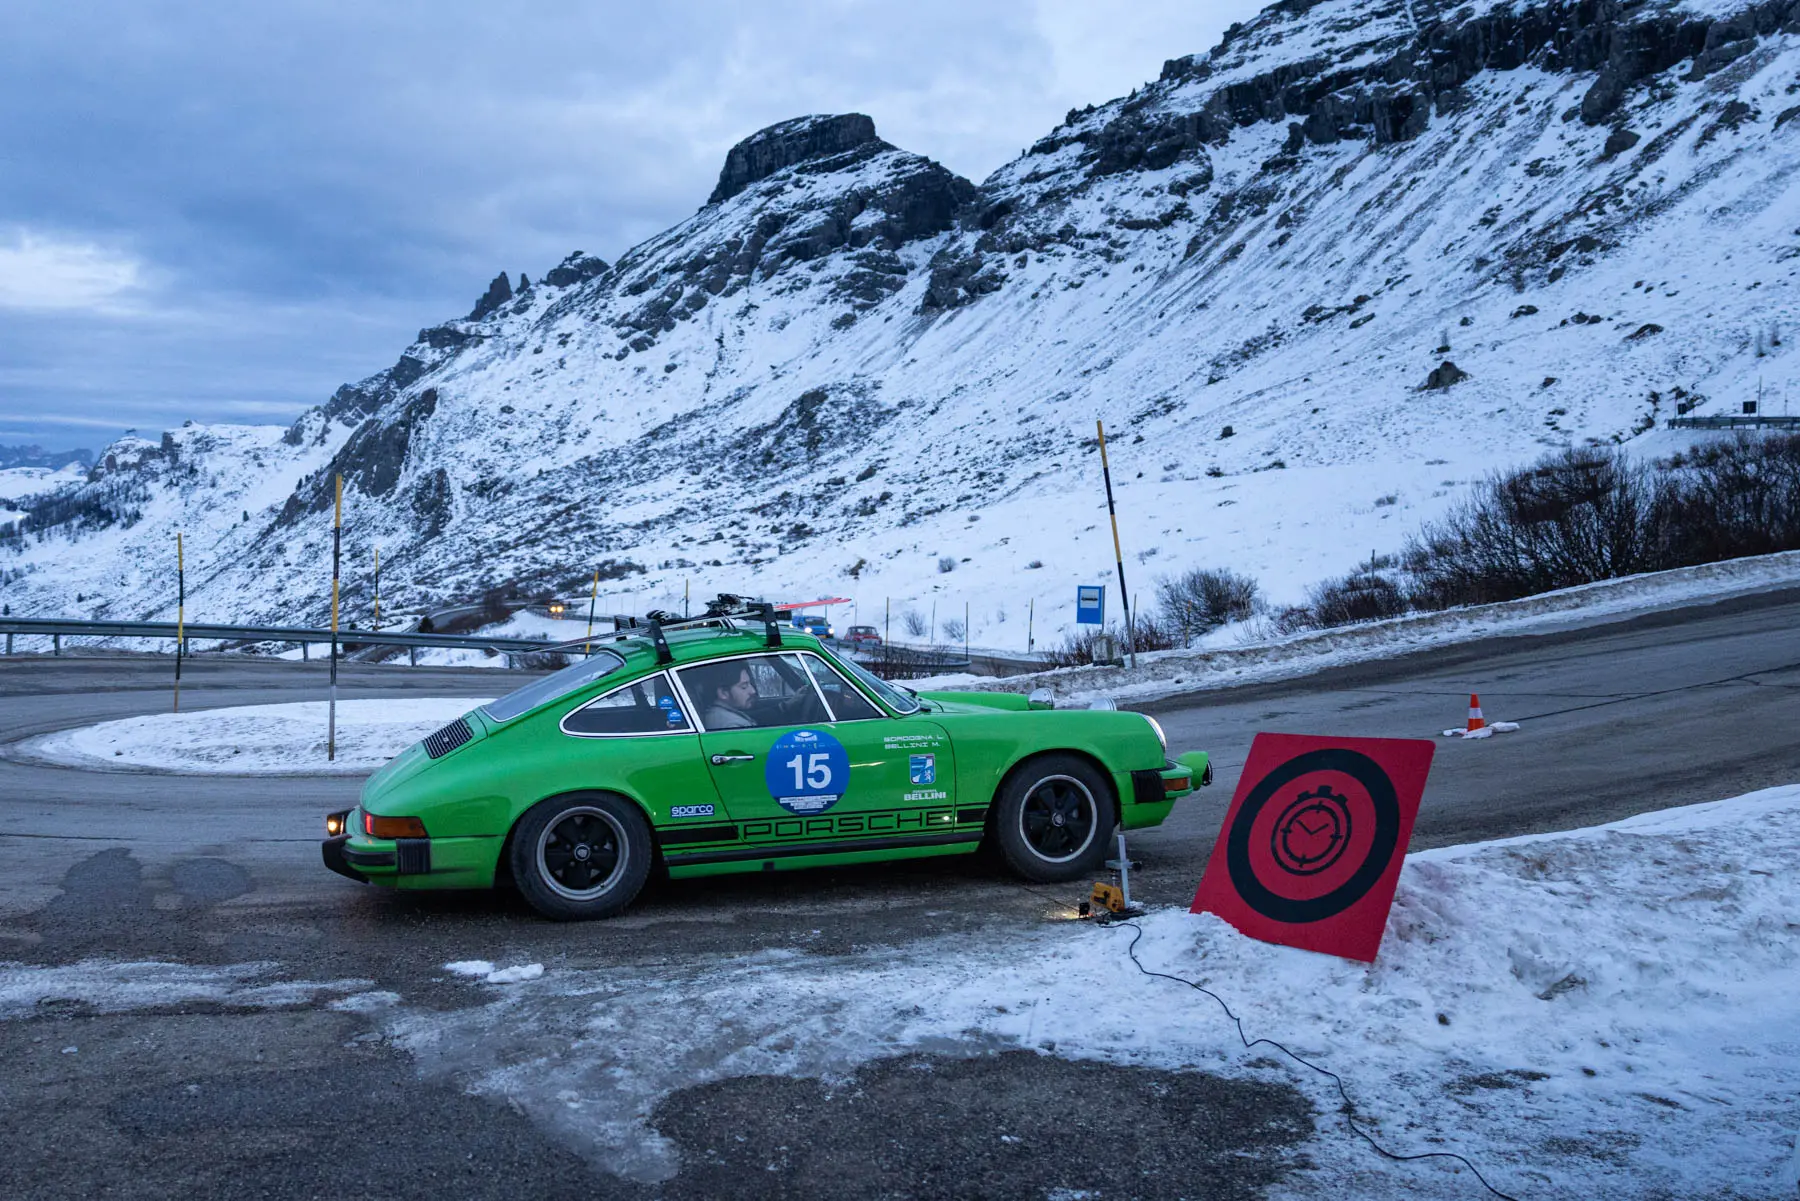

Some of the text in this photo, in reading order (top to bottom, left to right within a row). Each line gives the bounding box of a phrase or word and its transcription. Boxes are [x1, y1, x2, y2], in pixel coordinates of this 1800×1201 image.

[884, 742, 929, 750] BELLINI
[786, 753, 832, 790] 15
[903, 791, 947, 801] BELLINI
[671, 804, 714, 817] sparco
[744, 810, 953, 839] PORSCHE
